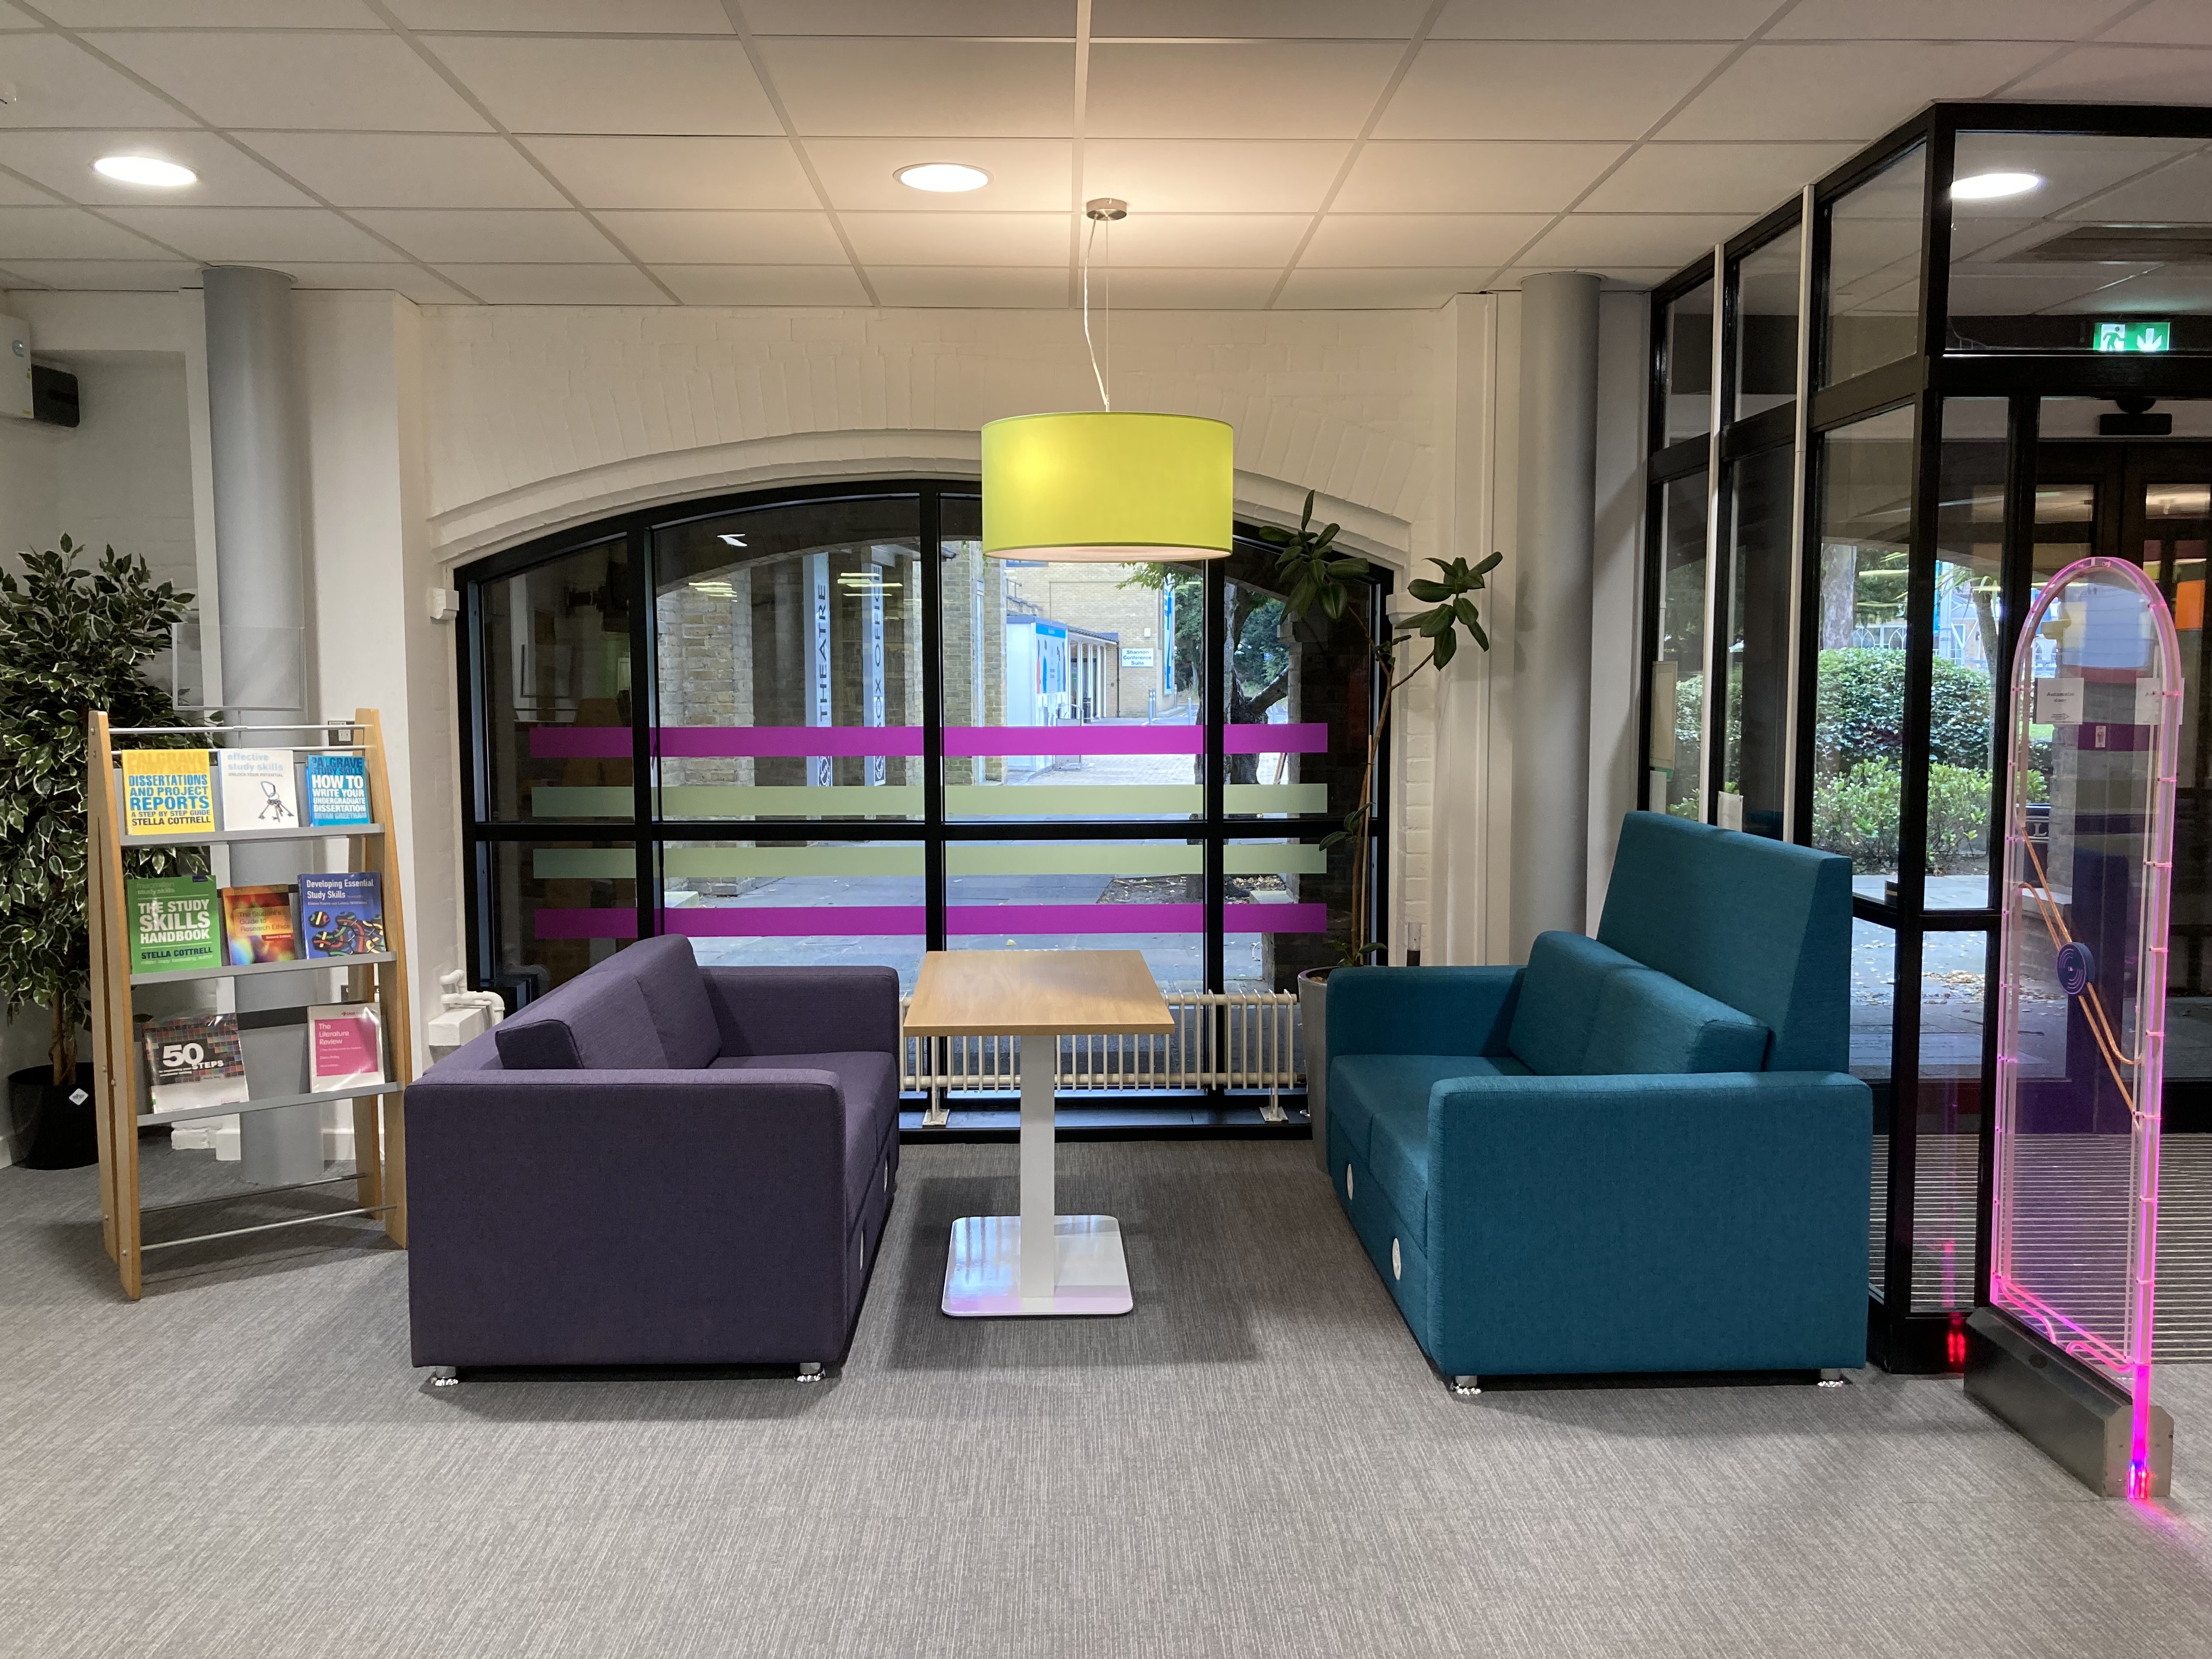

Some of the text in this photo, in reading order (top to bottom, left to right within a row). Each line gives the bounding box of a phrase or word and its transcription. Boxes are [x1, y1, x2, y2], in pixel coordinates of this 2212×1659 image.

[818, 584, 827, 722] THEATRE
[228, 753, 269, 761] effective
[312, 757, 363, 768] PALGRAVE
[228, 763, 284, 771] study skills
[129, 775, 207, 786] DISSERTATIONS
[312, 775, 364, 789] HOW TO
[130, 786, 208, 796] AND PROJECT
[312, 788, 364, 797] WRITE YOUR
[130, 796, 210, 810] REPORTS
[167, 816, 211, 825] COTTRELL
[306, 879, 374, 889] Developing Essential
[307, 891, 326, 900] Study
[328, 890, 346, 899] Skills
[138, 899, 210, 914] THE STUDY
[139, 911, 211, 932] SKILLS
[140, 928, 211, 944] HANDBOOK
[142, 947, 213, 959] STELLA COTTRELL
[163, 1043, 204, 1067] 50
[193, 1060, 224, 1070] STEPS
